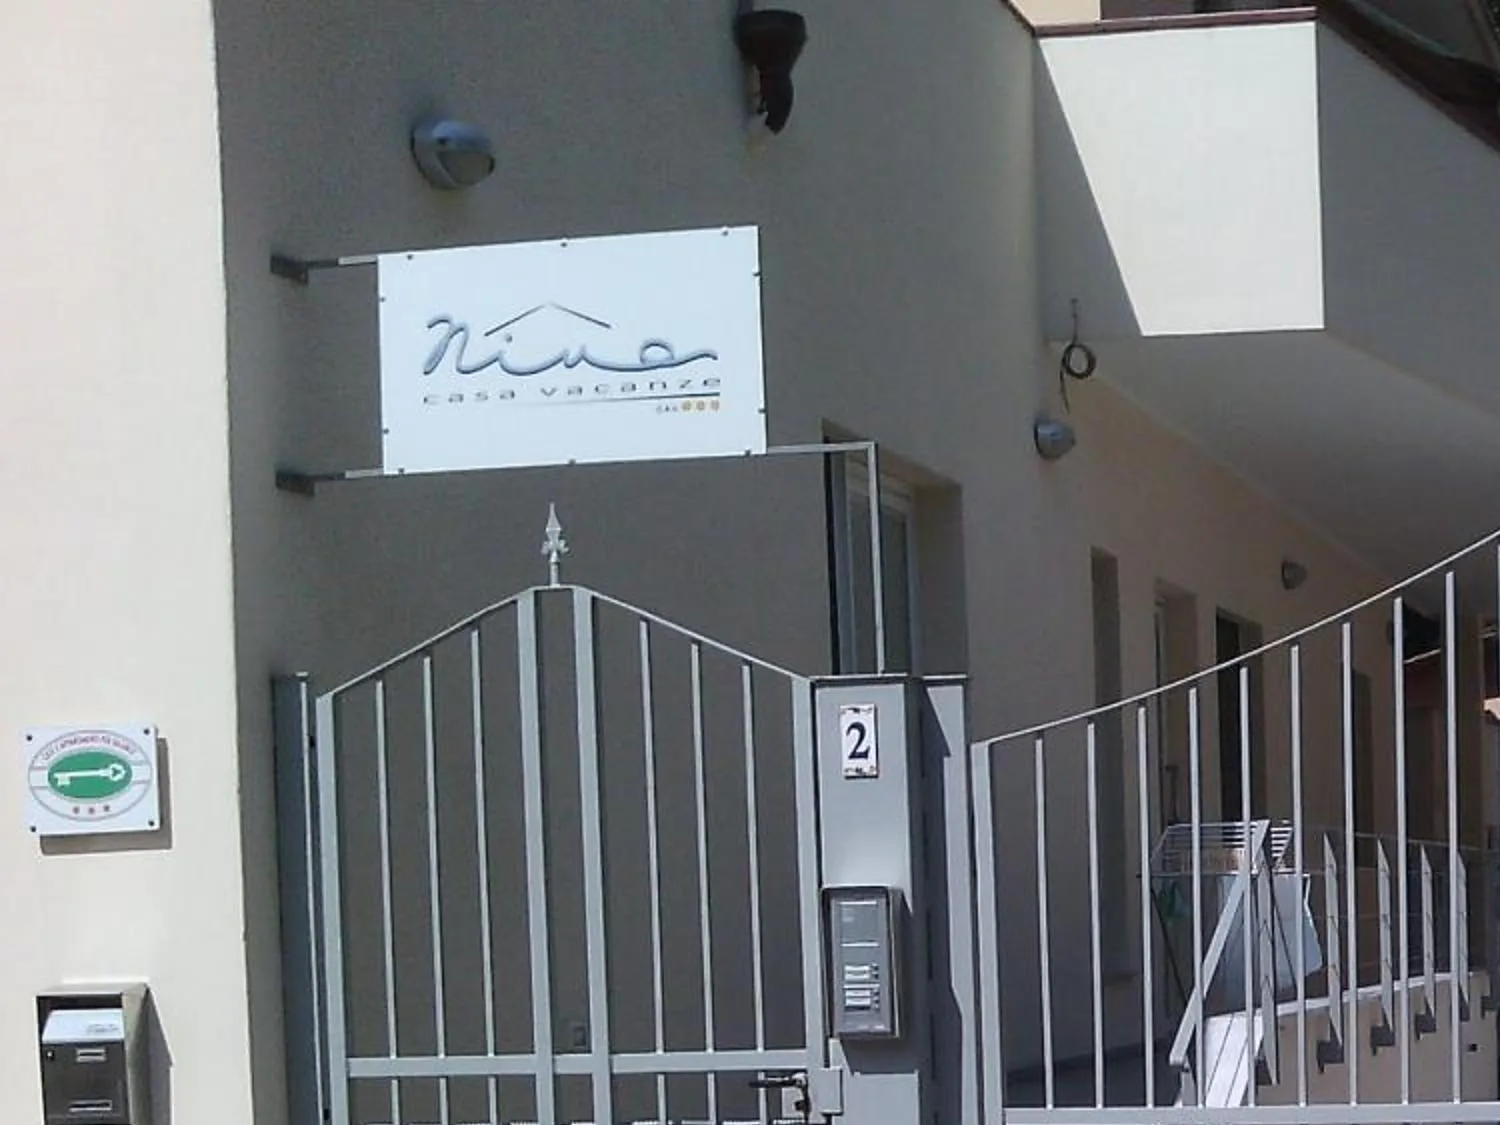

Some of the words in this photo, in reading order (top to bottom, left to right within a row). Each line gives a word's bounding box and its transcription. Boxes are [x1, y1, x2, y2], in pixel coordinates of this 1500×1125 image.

[423, 387, 515, 405] casa
[540, 375, 721, 397] vacanze
[845, 721, 871, 760] 2
